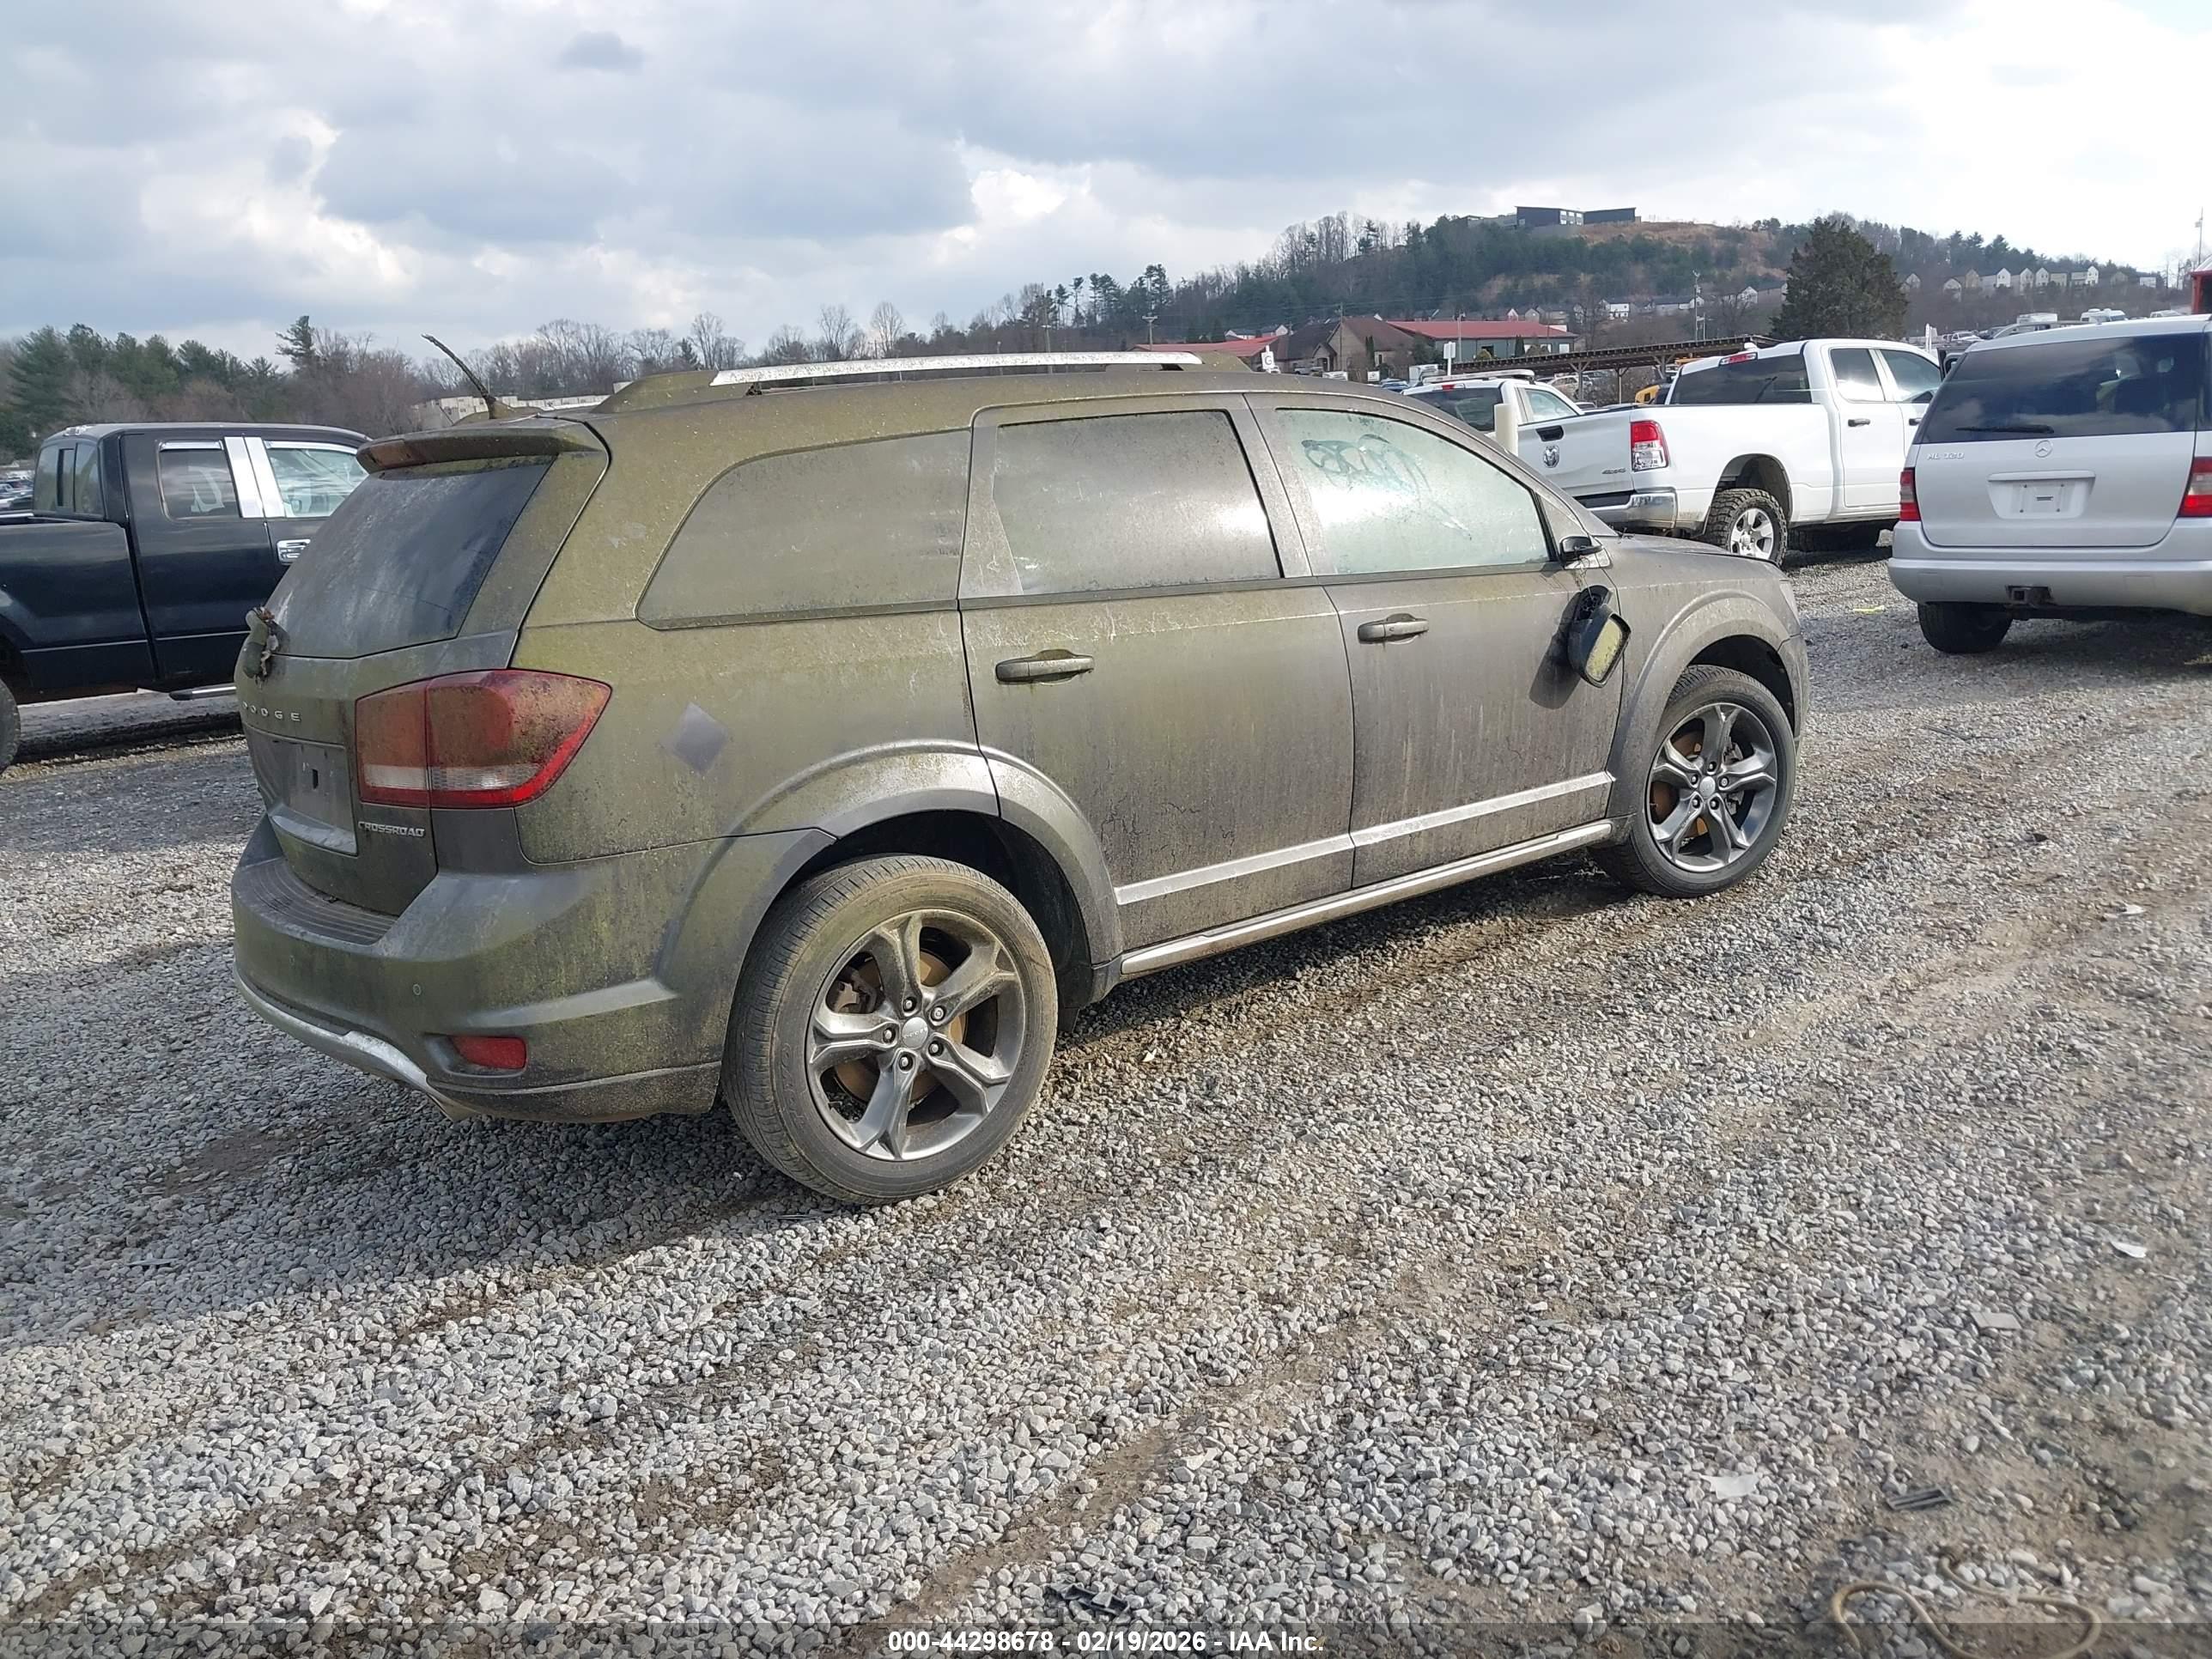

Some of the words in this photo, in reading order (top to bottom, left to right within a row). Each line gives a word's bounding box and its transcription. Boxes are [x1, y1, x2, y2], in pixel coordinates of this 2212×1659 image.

[1264, 355, 1273, 366] G
[242, 701, 301, 721] DODGE
[357, 821, 425, 837] CROSSROAD
